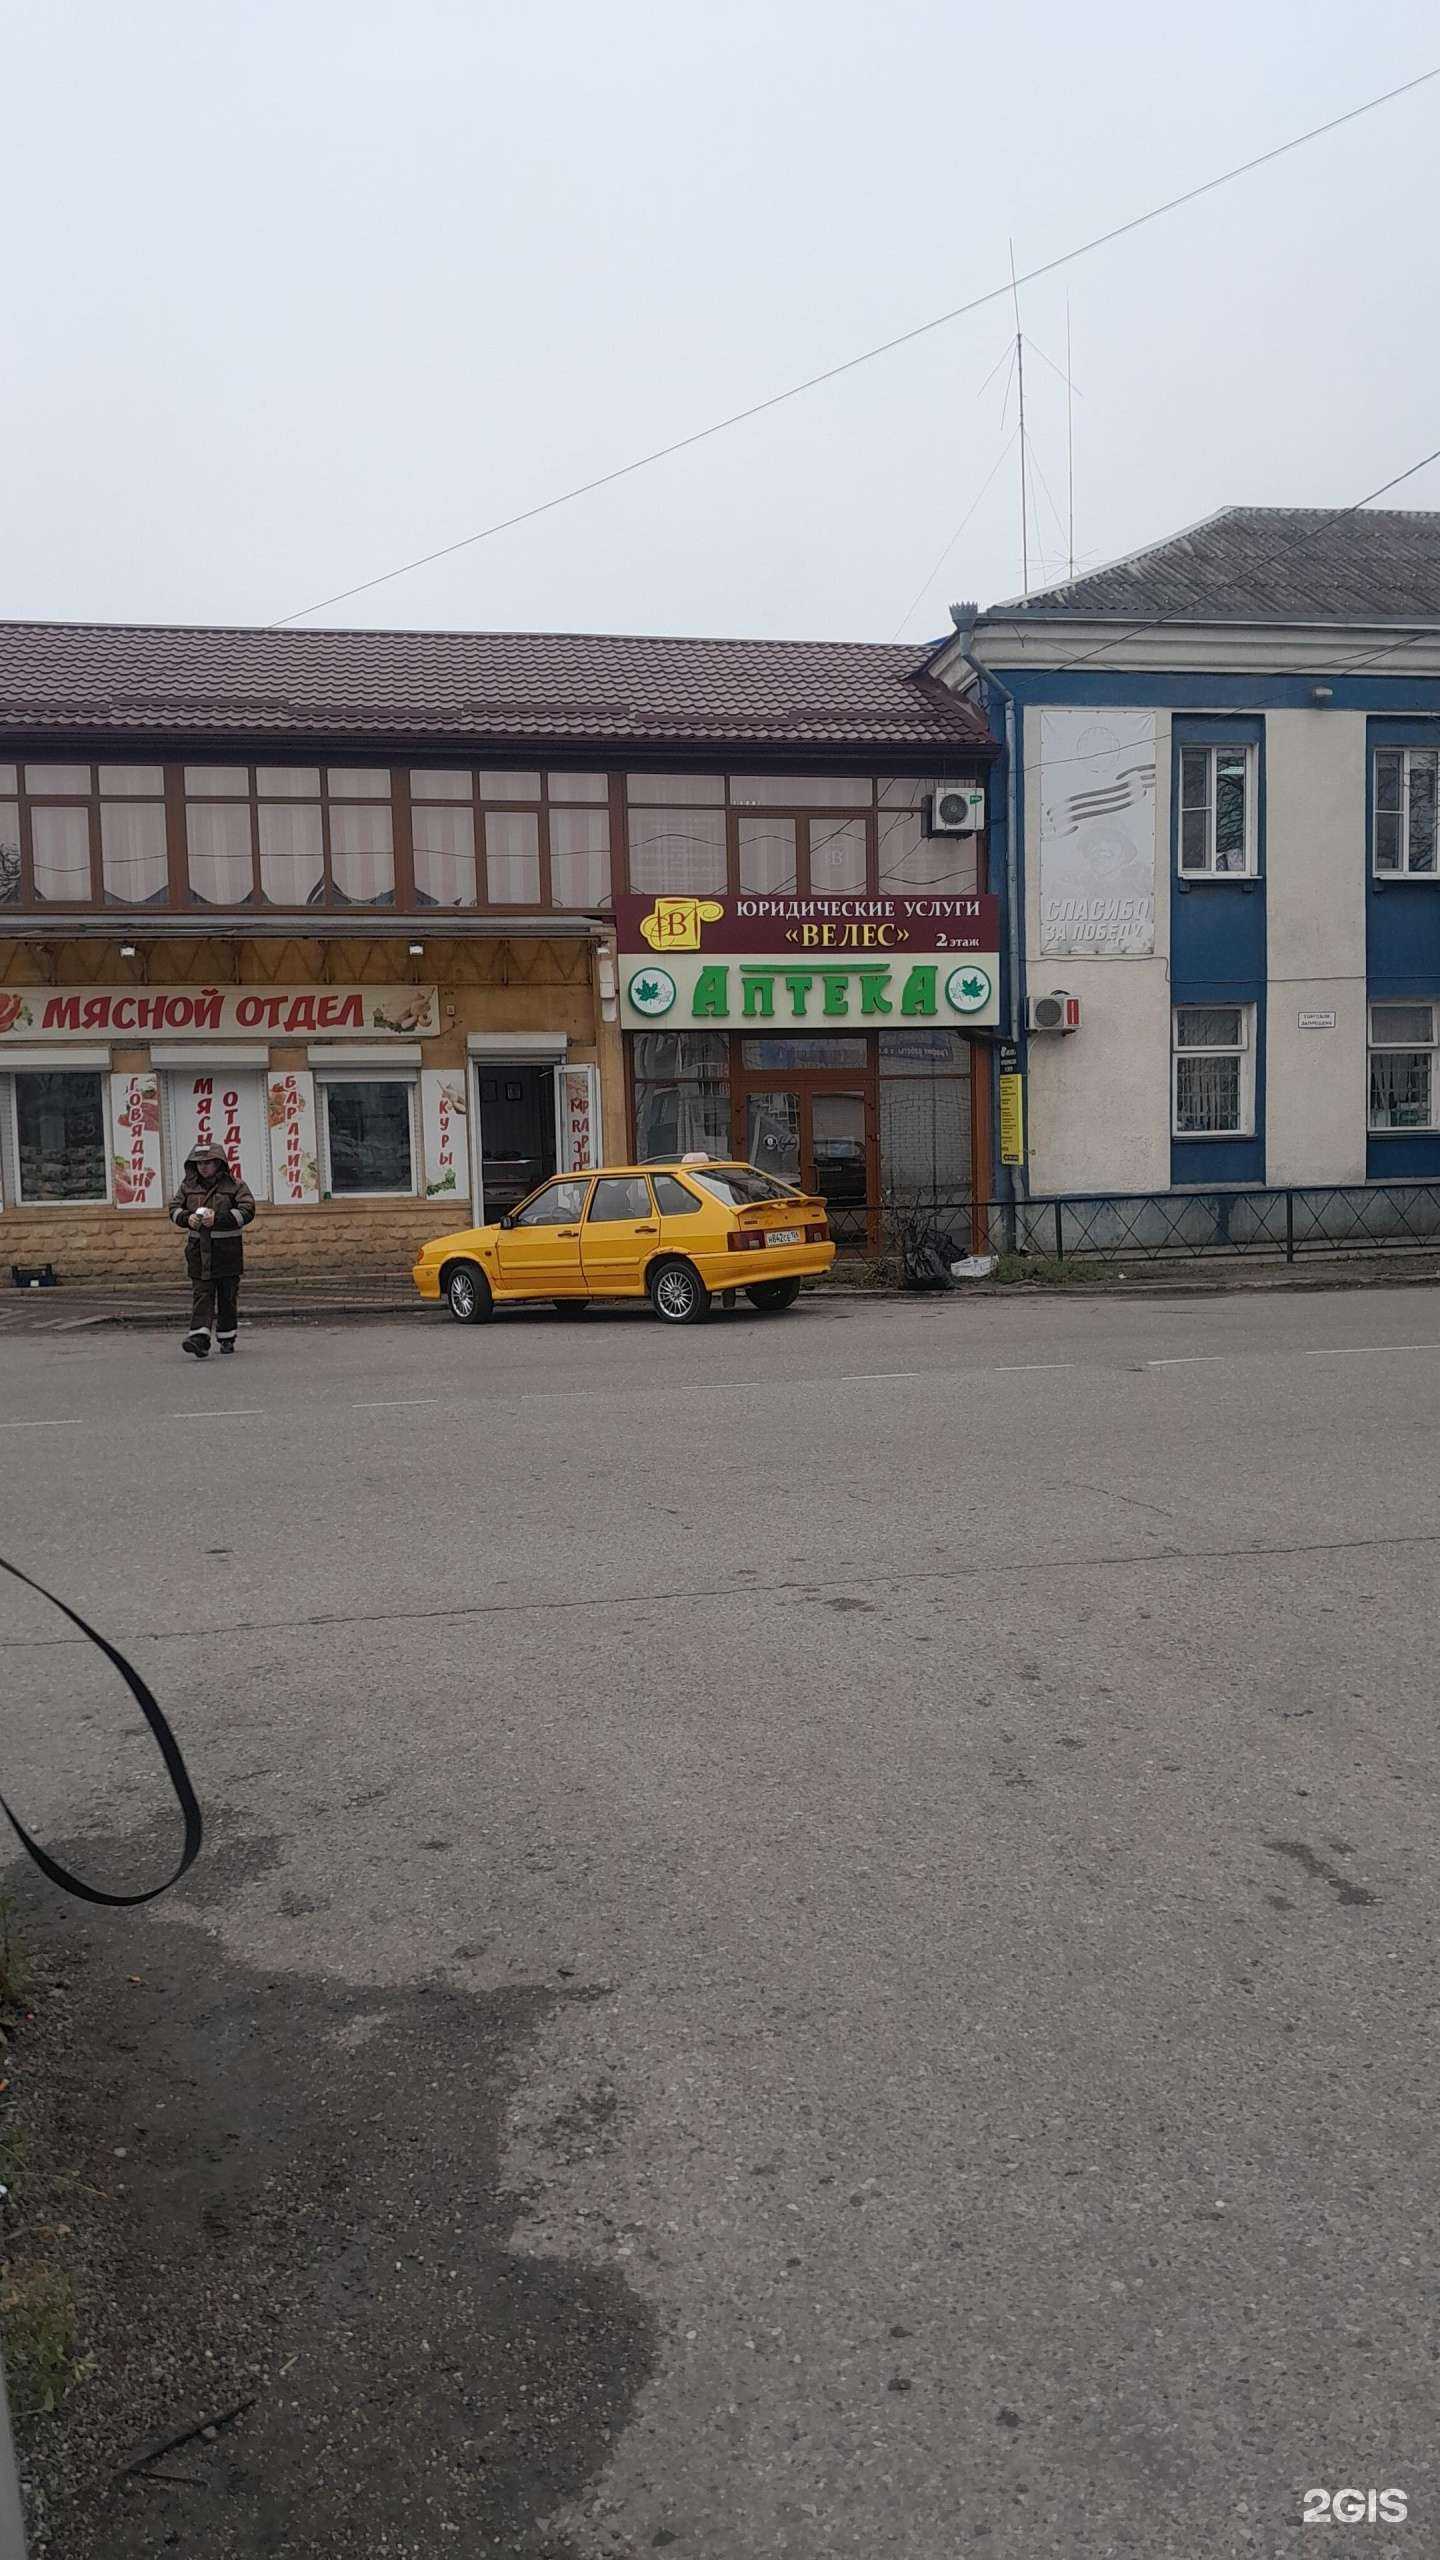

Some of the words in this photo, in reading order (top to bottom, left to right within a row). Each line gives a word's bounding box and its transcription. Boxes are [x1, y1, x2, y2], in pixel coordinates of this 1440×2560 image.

[736, 901, 895, 919] ЮРИДИЧЕСКИЕ
[904, 901, 981, 917] УСЛУГИ
[1046, 899, 1150, 921] СПАСИБО
[1046, 925, 1067, 941] ЗА
[785, 922, 910, 948] «ВЕЛЕС»
[936, 932, 947, 947] 2
[950, 937, 980, 948] этаж
[42, 986, 225, 1030] МЯСНОЙ
[235, 993, 364, 1032] ОТДЕЛ
[692, 964, 938, 1017] АПТЕКА
[192, 1077, 214, 1146] МЯСН
[222, 1090, 242, 1182] ОТДЕЛ
[438, 1100, 453, 1165] КУРЫ
[128, 1077, 146, 1203] ГОВЯДИНА
[284, 1075, 303, 1199] БАРАНИНА
